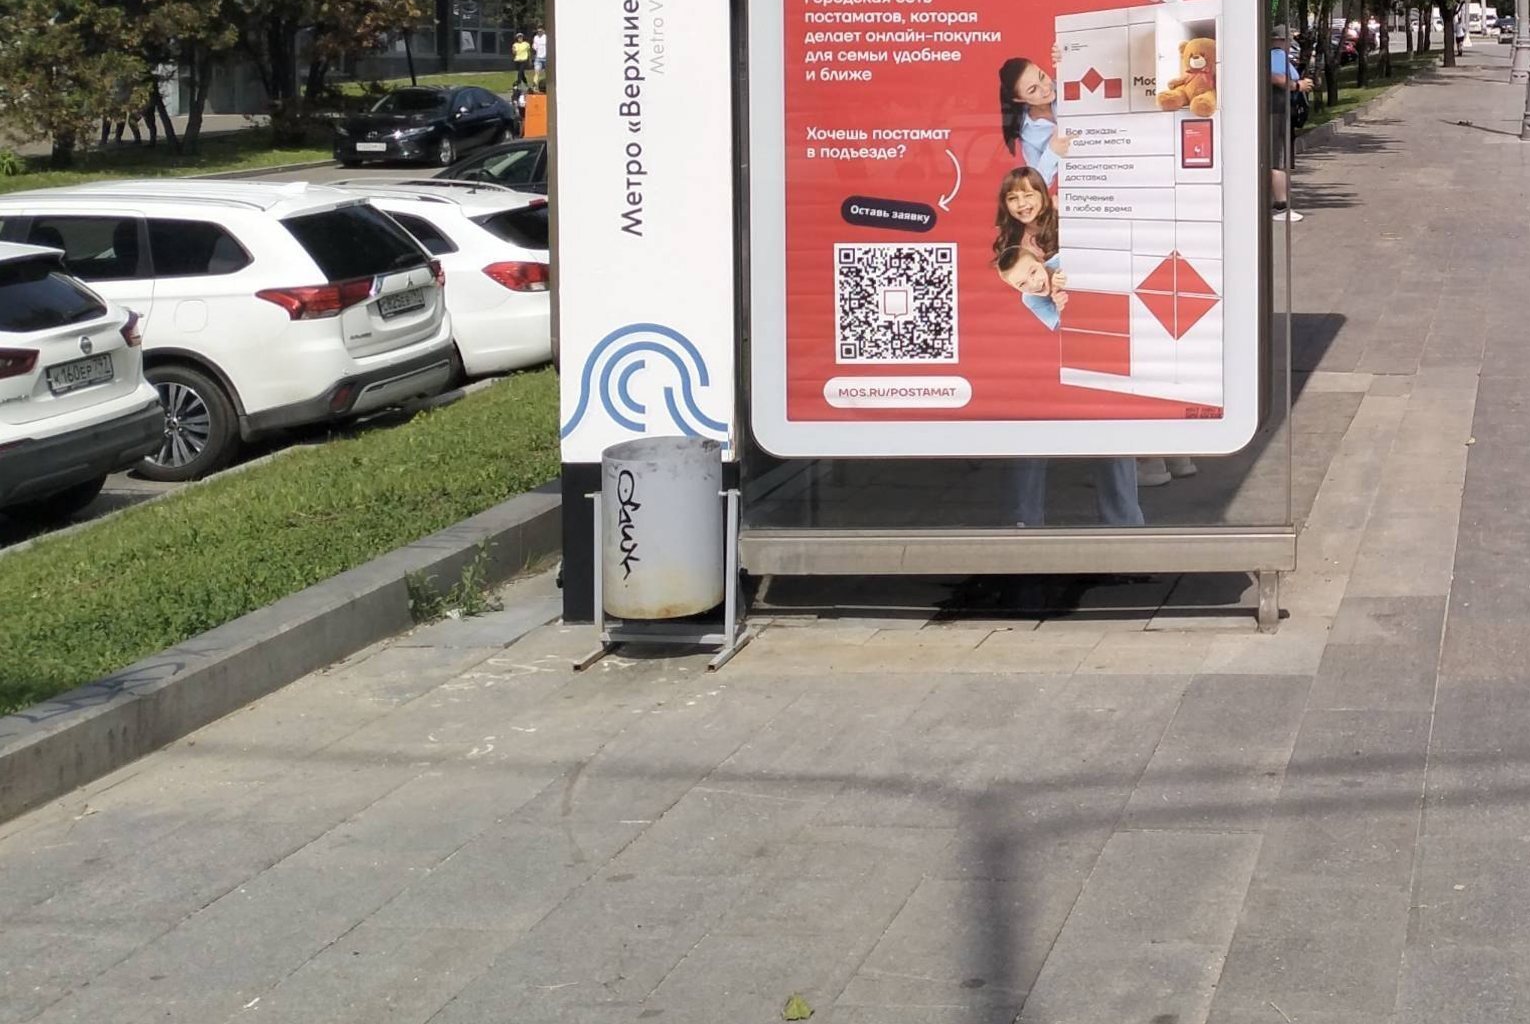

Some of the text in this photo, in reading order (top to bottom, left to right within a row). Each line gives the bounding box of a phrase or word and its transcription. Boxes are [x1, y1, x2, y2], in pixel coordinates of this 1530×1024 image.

[804, 12, 978, 25] постаматов, которая
[804, 28, 1001, 44] делает онлайн-покупки
[650, 17, 665, 74] Metro
[805, 48, 962, 64] для семьи удобнее
[805, 68, 873, 81] и ближе
[806, 127, 951, 140] Хочешь постамат
[806, 144, 907, 160] в подъезде?
[620, 141, 648, 237] Метро
[850, 205, 931, 224] Оставь заявку
[838, 387, 956, 397] MOS.RU/POSTAMAT
